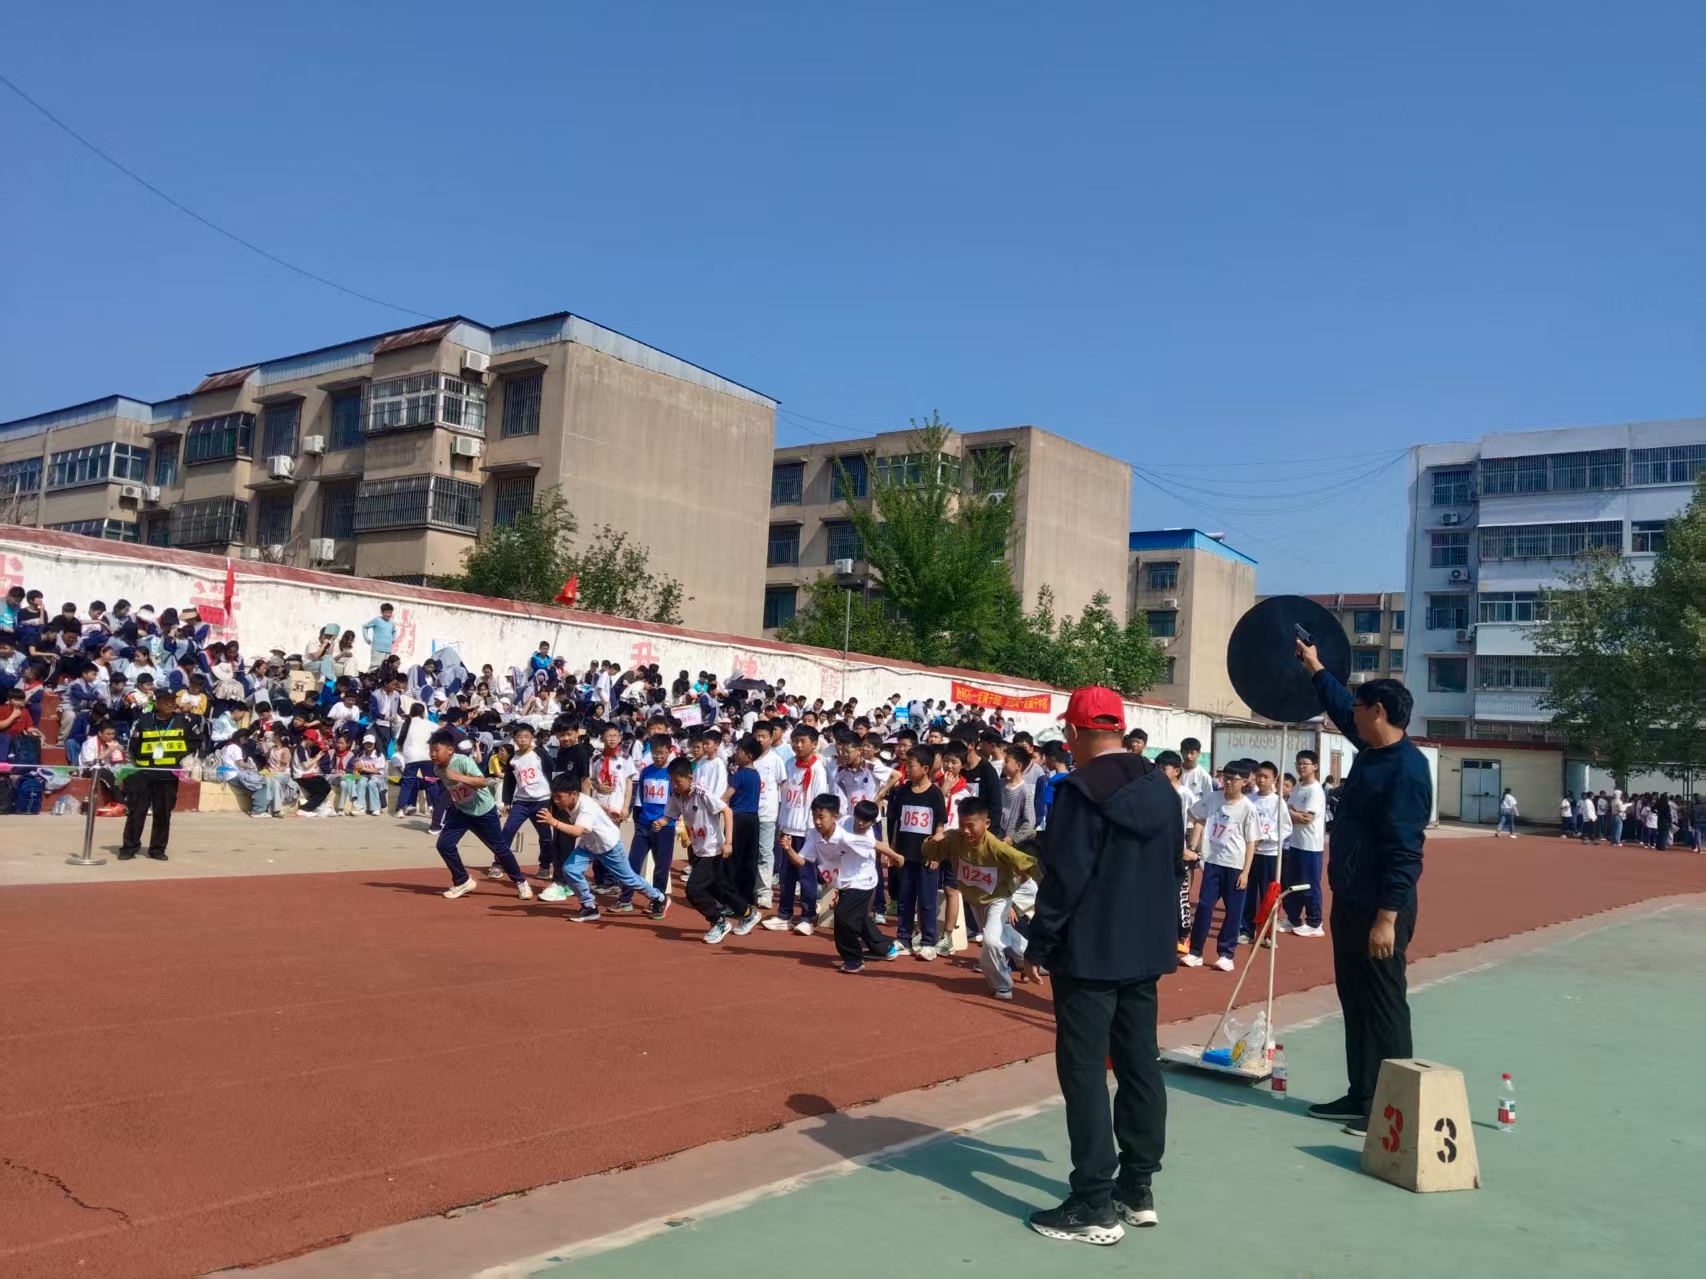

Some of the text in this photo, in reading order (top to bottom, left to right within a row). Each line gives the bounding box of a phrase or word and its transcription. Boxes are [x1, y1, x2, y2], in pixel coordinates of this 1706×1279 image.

[644, 784, 665, 800] 044
[904, 810, 930, 829] 053
[1212, 822, 1233, 839] 17
[962, 865, 993, 886] 024
[1380, 1103, 1404, 1153] 3
[1434, 1117, 1457, 1164] 3
